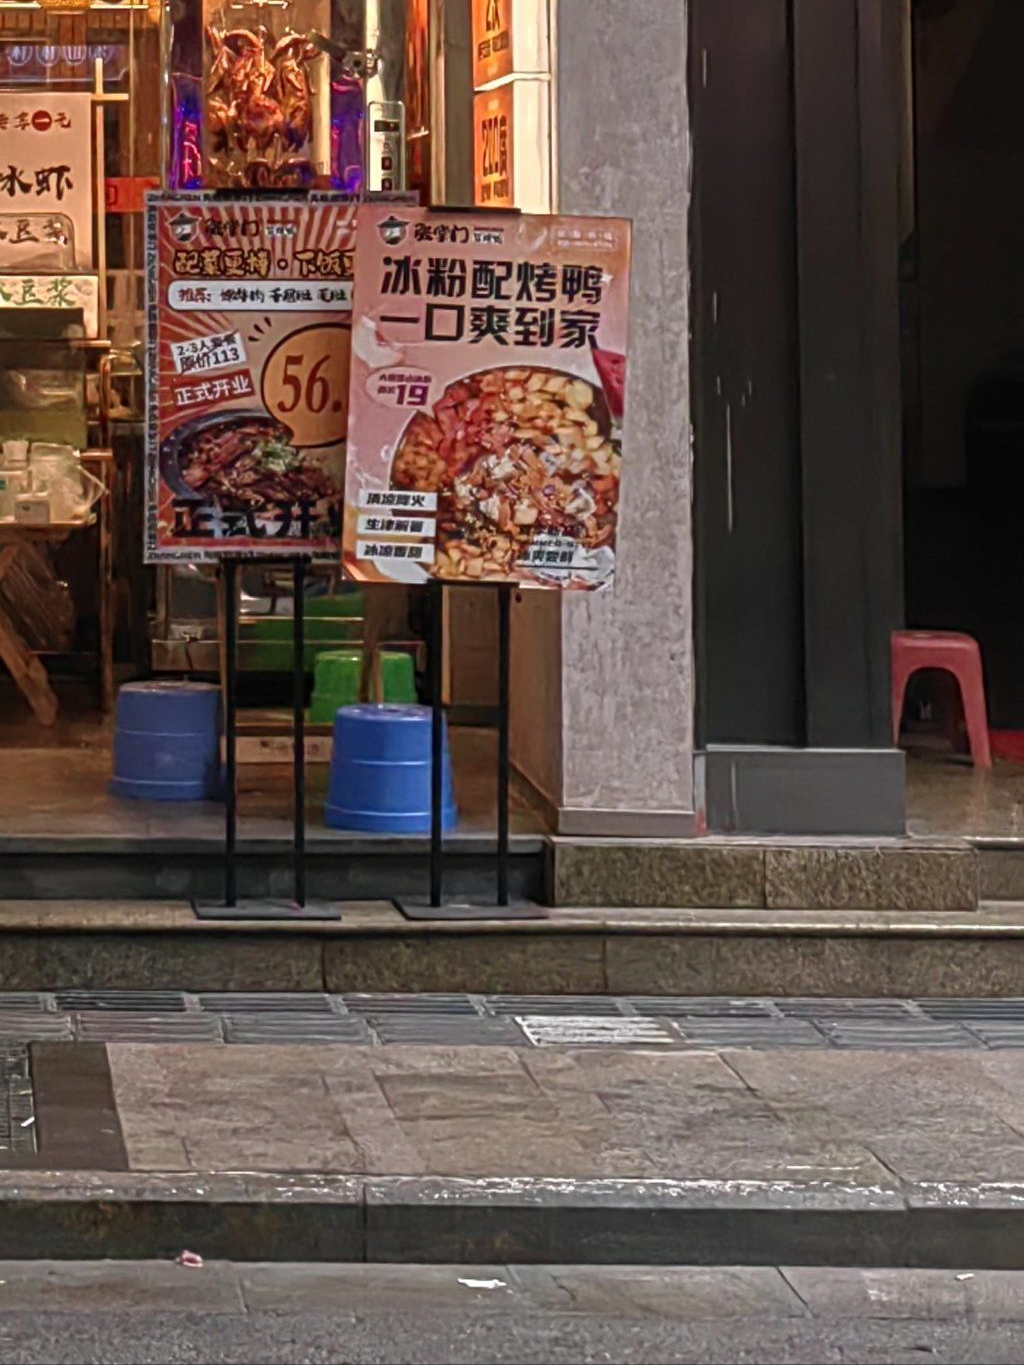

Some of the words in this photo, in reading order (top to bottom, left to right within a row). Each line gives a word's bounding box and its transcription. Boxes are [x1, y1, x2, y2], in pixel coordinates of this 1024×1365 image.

[380, 255, 604, 305] 冰粉配烤鸭
[379, 302, 602, 349] 一口爽到家
[175, 374, 252, 407] 正式开业
[396, 383, 429, 406] 19
